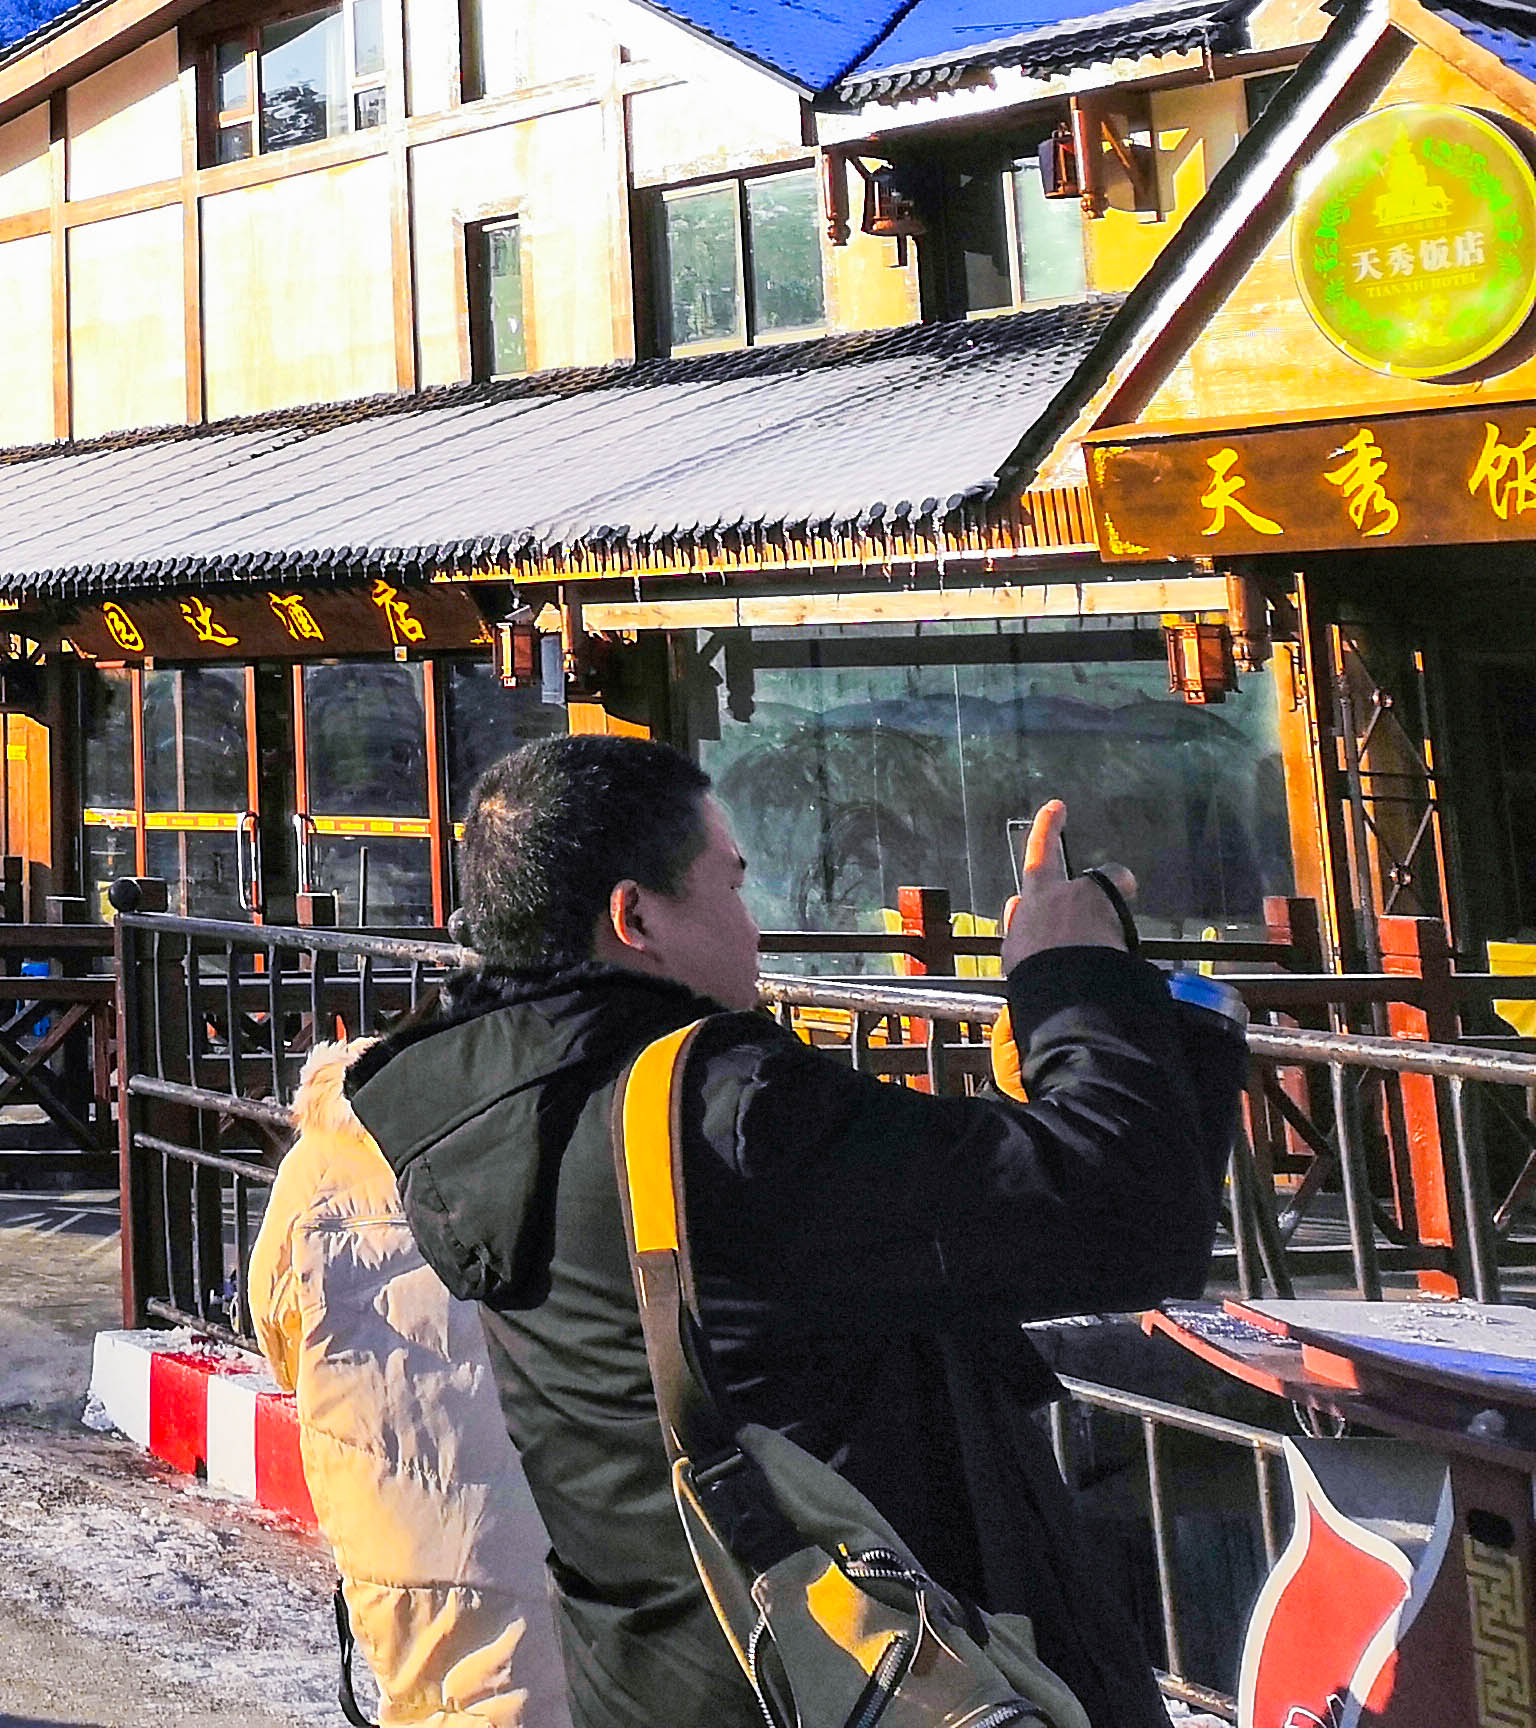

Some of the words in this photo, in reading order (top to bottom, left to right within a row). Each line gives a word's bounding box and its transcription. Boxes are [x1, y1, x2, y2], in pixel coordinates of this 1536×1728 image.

[1351, 230, 1485, 283] 天秀饭店
[1431, 271, 1480, 289] HOTEL
